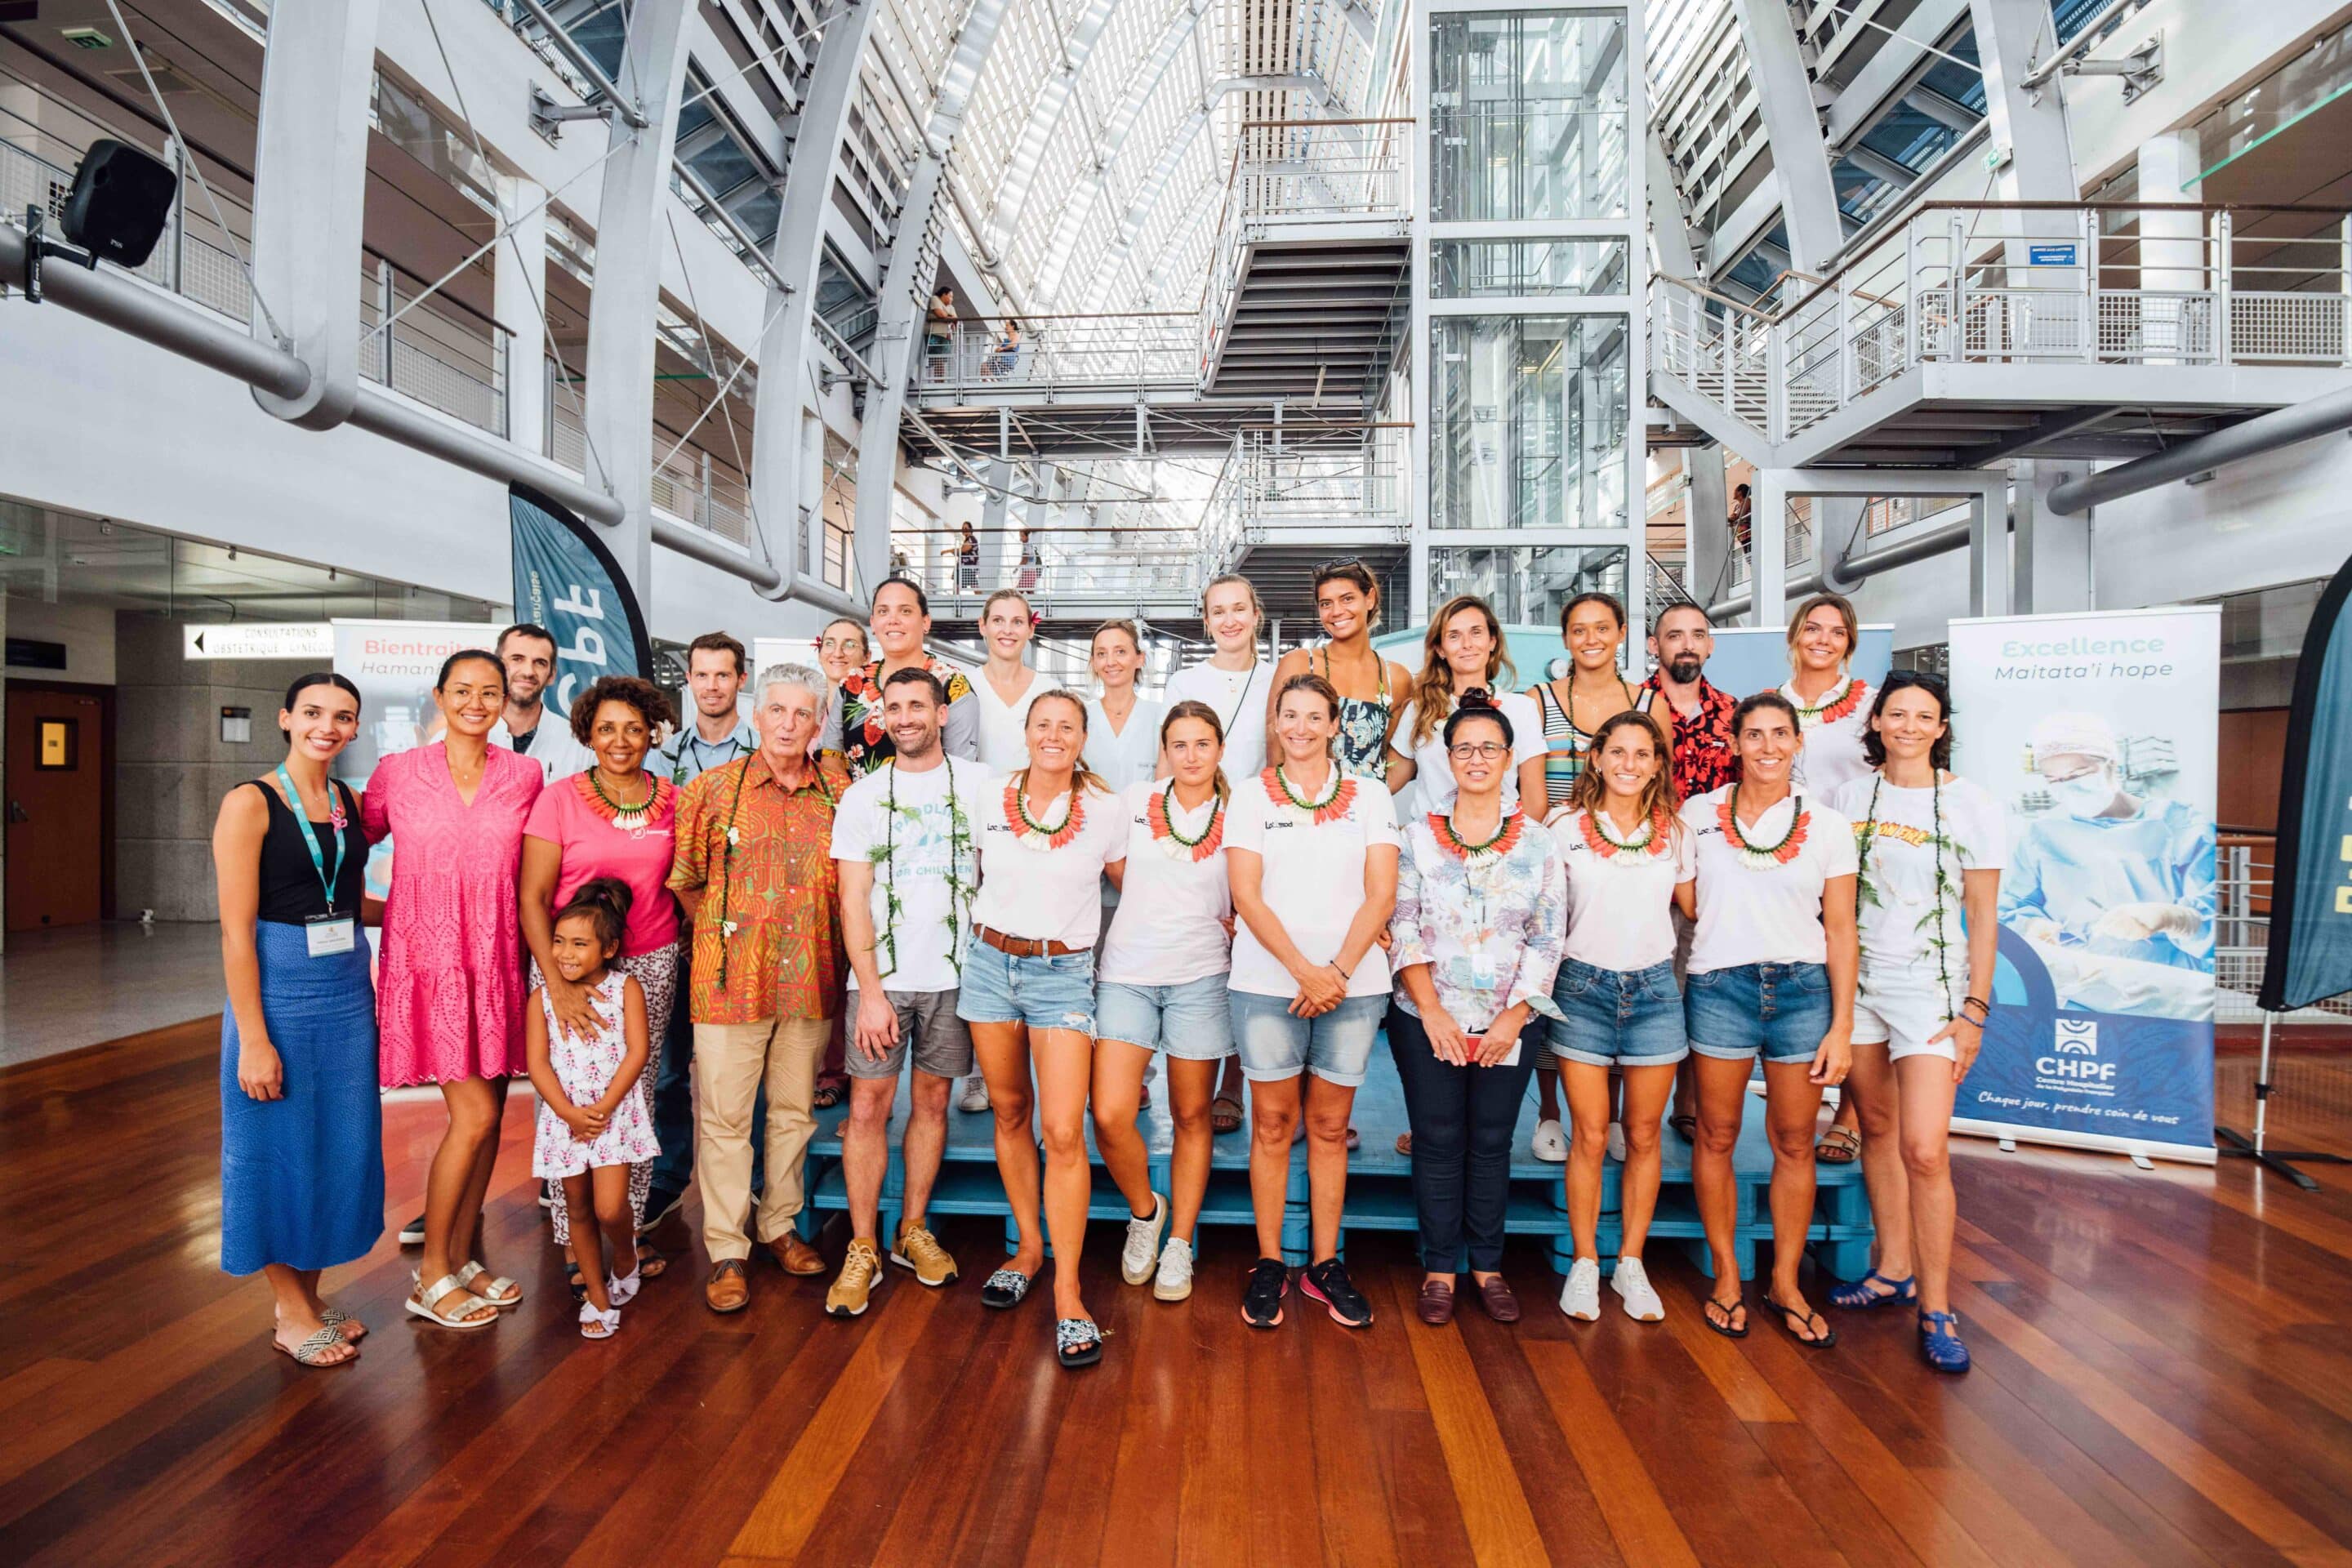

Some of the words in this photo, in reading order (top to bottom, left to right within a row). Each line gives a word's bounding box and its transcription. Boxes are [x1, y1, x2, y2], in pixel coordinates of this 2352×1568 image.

[2001, 636, 2167, 657] Excellence
[2109, 662, 2173, 680] hope
[915, 864, 973, 876] CHILDEN
[2035, 1057, 2117, 1081] CHPF
[1977, 1090, 2021, 1107] Chaque
[2051, 1102, 2102, 1116] prendre
[2104, 1107, 2130, 1119] soin
[2132, 1109, 2149, 1121] de
[2150, 1114, 2180, 1125] vous
